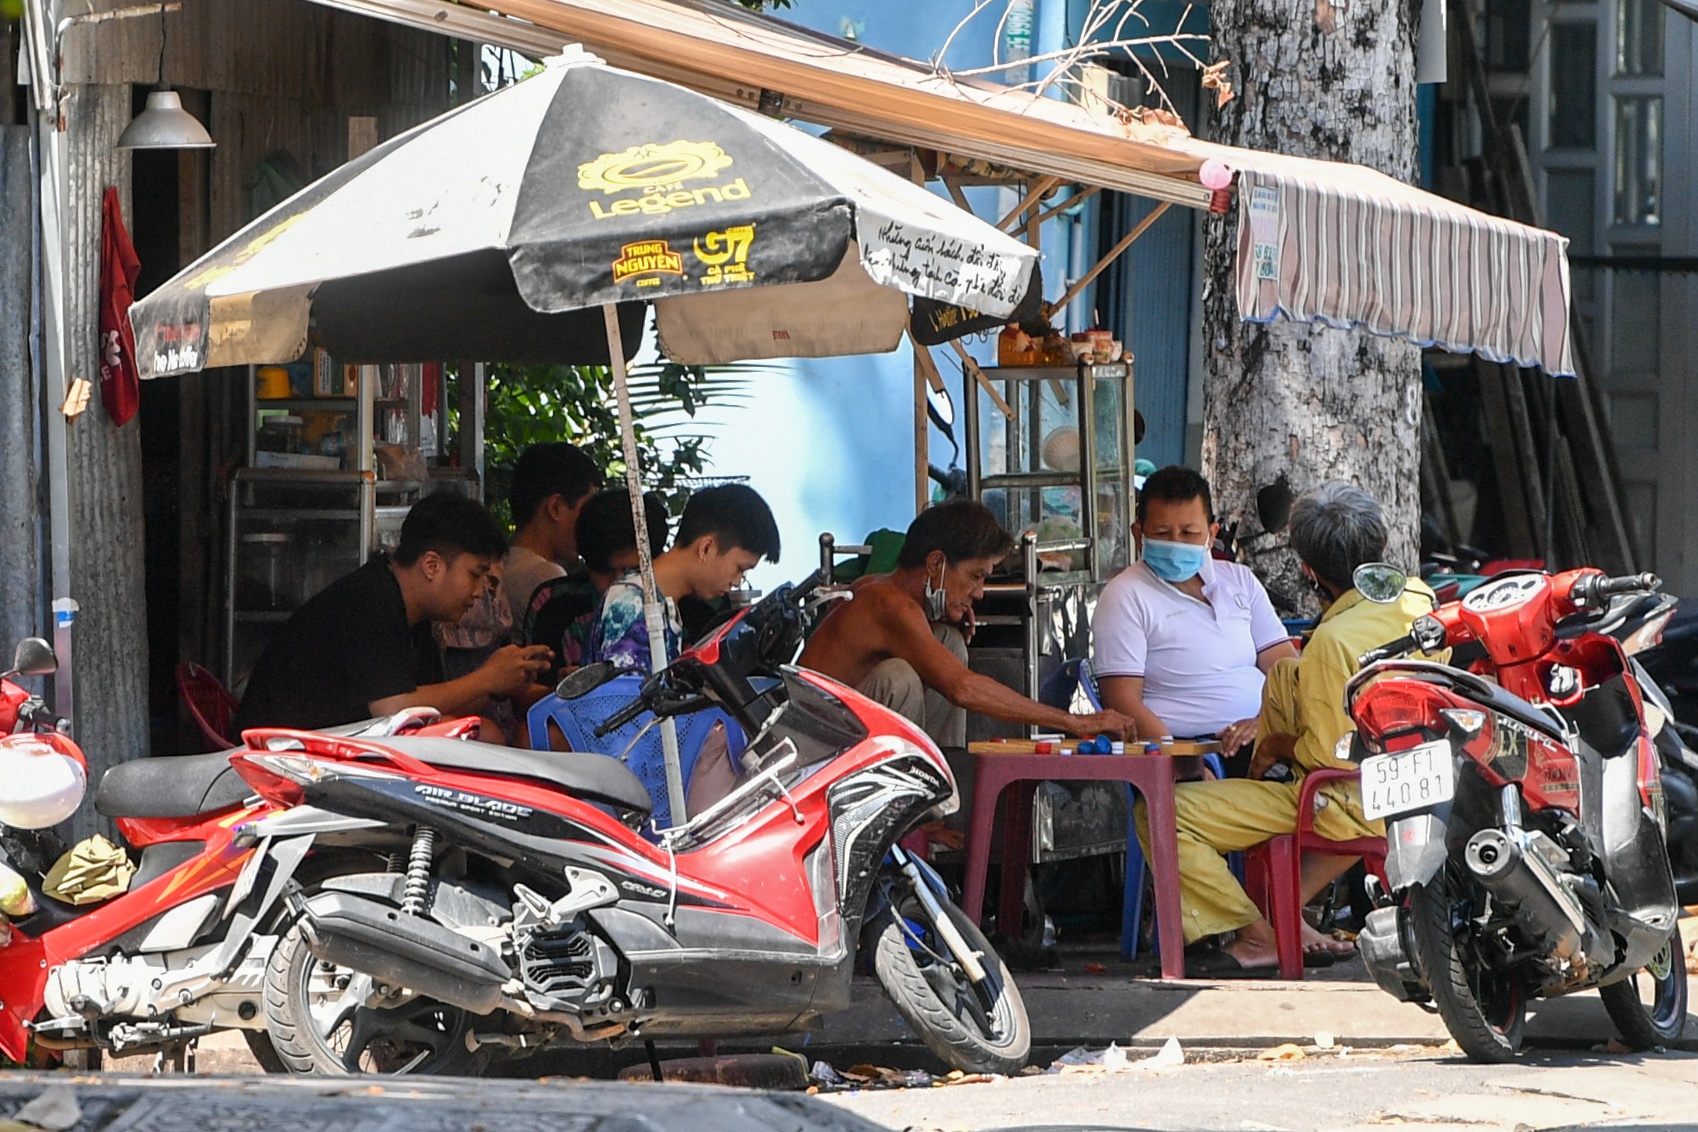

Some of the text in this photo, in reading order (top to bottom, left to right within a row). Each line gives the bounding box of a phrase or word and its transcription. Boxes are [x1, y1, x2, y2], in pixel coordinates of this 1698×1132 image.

[589, 178, 751, 220] Legend
[626, 242, 663, 257] TRUNG
[693, 224, 754, 265] G7
[615, 252, 679, 277] NGUYÊN
[914, 768, 941, 788] HONDA
[414, 784, 534, 817] AIR BLADE
